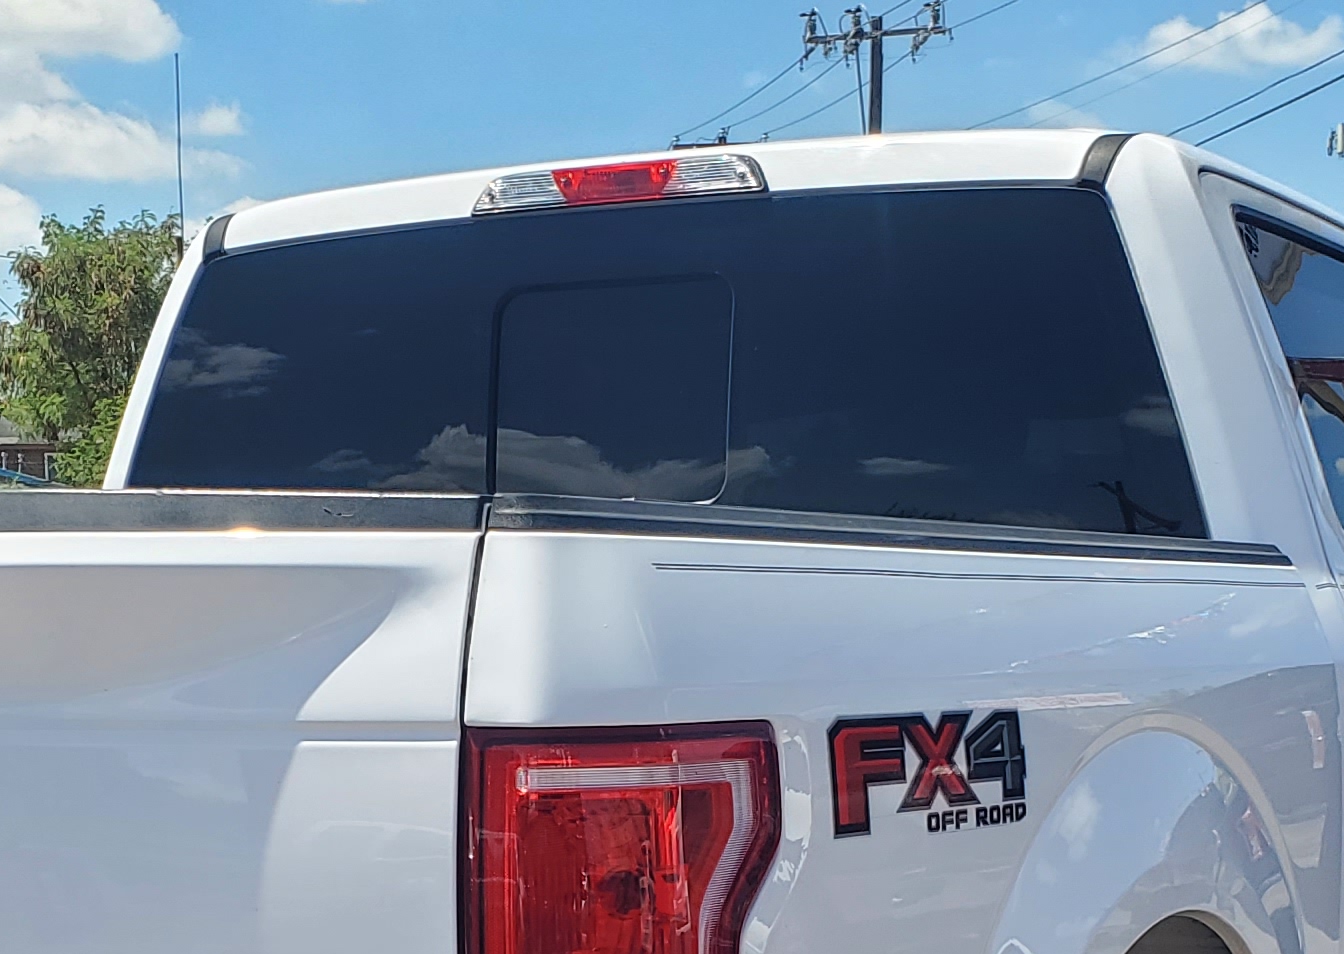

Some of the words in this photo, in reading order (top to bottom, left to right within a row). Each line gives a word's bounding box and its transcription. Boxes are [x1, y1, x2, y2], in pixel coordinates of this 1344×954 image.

[826, 708, 1027, 840] FX4
[926, 809, 968, 834] OFF
[975, 802, 1027, 828] ROAD
